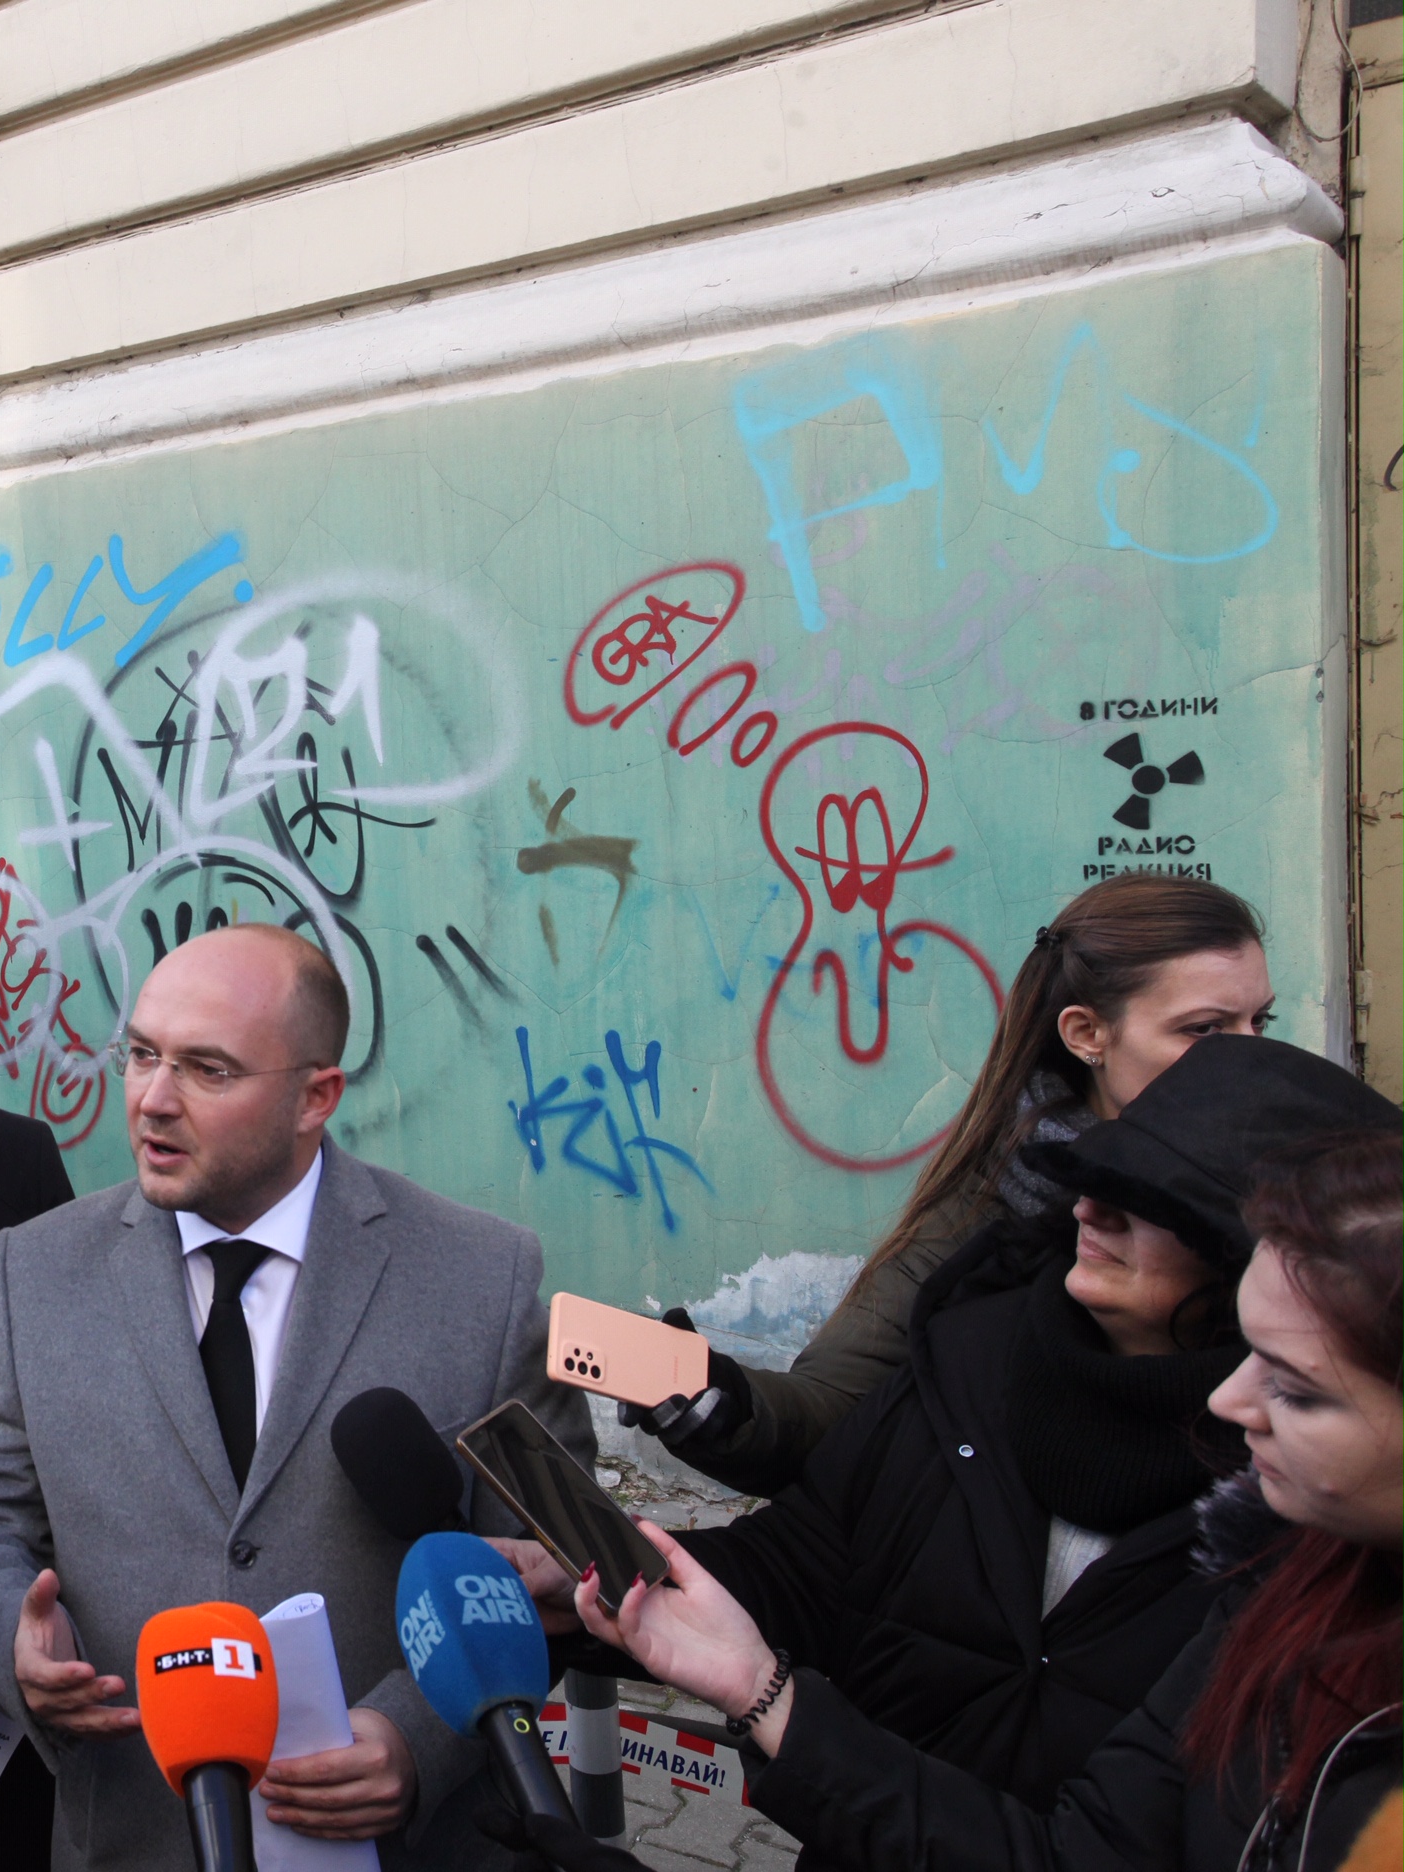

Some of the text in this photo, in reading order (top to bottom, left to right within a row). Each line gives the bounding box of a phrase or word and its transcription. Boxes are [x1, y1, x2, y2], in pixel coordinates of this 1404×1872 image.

[1079, 697, 1219, 721] 8 ГОДИНИ
[1098, 835, 1196, 856] РАДИО
[454, 1575, 517, 1600] ON
[401, 1595, 430, 1650] ON
[461, 1598, 528, 1625] AIR
[224, 1645, 245, 1670] 1
[408, 1620, 444, 1682] AIR
